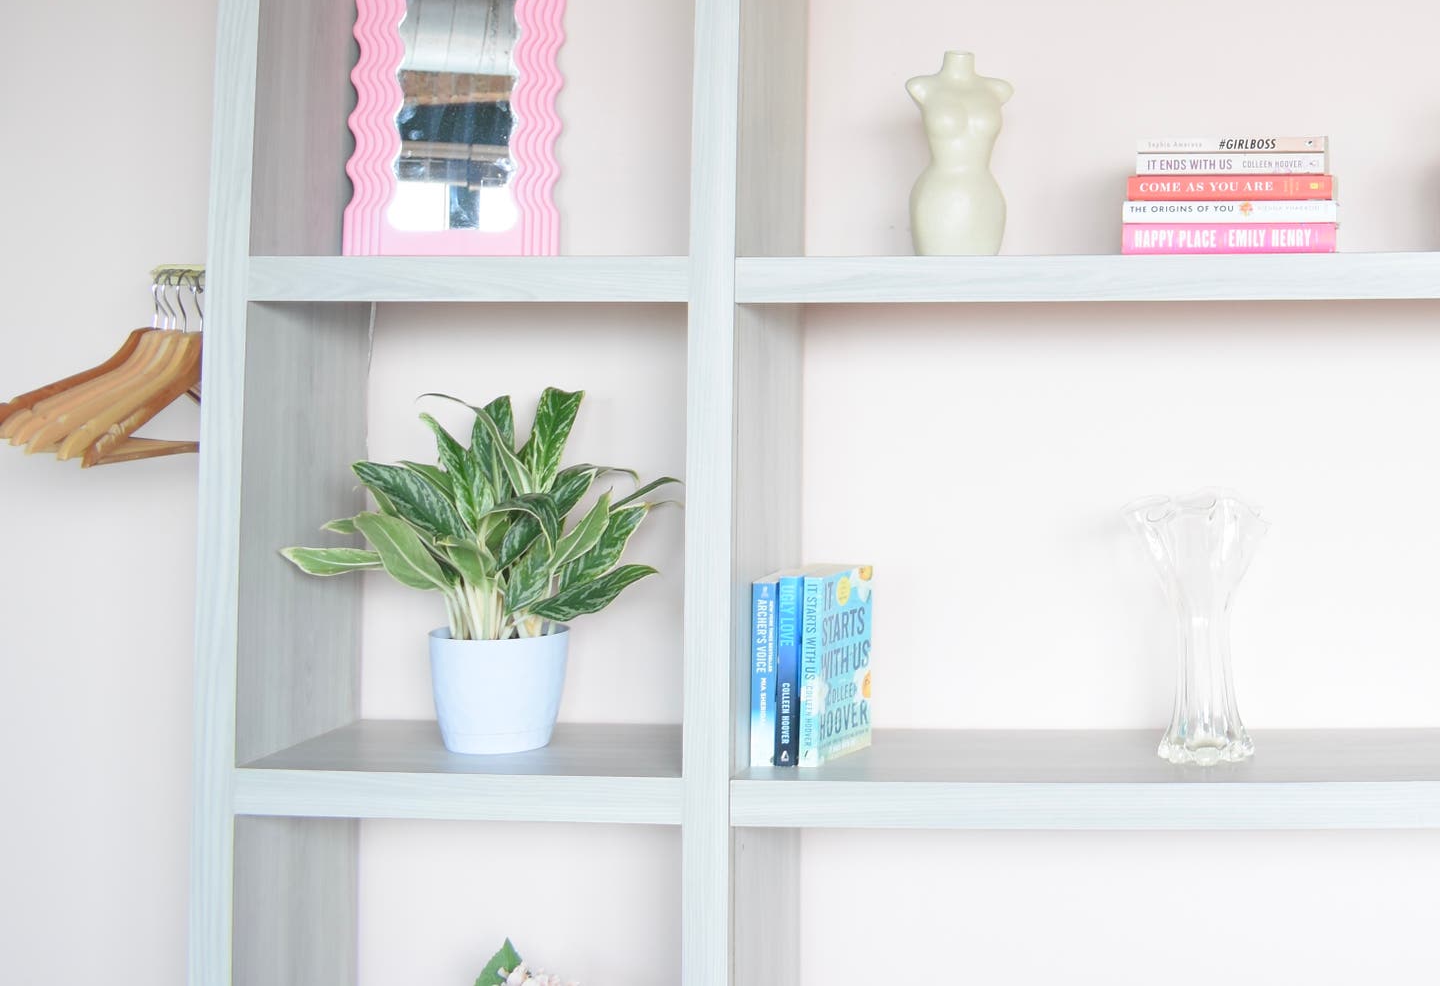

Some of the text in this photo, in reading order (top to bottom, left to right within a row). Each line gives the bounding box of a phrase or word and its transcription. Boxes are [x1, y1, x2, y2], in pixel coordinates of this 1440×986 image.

[1218, 138, 1277, 150] #GIRLBOSS
[1147, 159, 1233, 171] IT ENDS WITH US
[1242, 160, 1303, 169] COLLEEN HOOVER
[1139, 182, 1181, 193] COME
[1185, 182, 1205, 192] AS
[1206, 182, 1239, 192] YOU
[1243, 181, 1274, 192] ARE
[1130, 205, 1235, 214] THE ORIGINS OF YOU
[1134, 230, 1217, 248] HAPPY PLACE
[1228, 229, 1312, 248] EMILY HENRY
[824, 581, 834, 612] IT
[757, 599, 768, 645] ARCHER'S
[780, 584, 795, 647] UGLY LOVE
[821, 606, 866, 647] STARTS
[804, 583, 818, 681] IT STARTS WITH US
[756, 646, 767, 673] VOICE
[821, 639, 871, 681] WITH US
[781, 682, 791, 745] COLLEEN HOOVER
[819, 699, 869, 741] HOOVER
[804, 717, 813, 747] HOOVER
